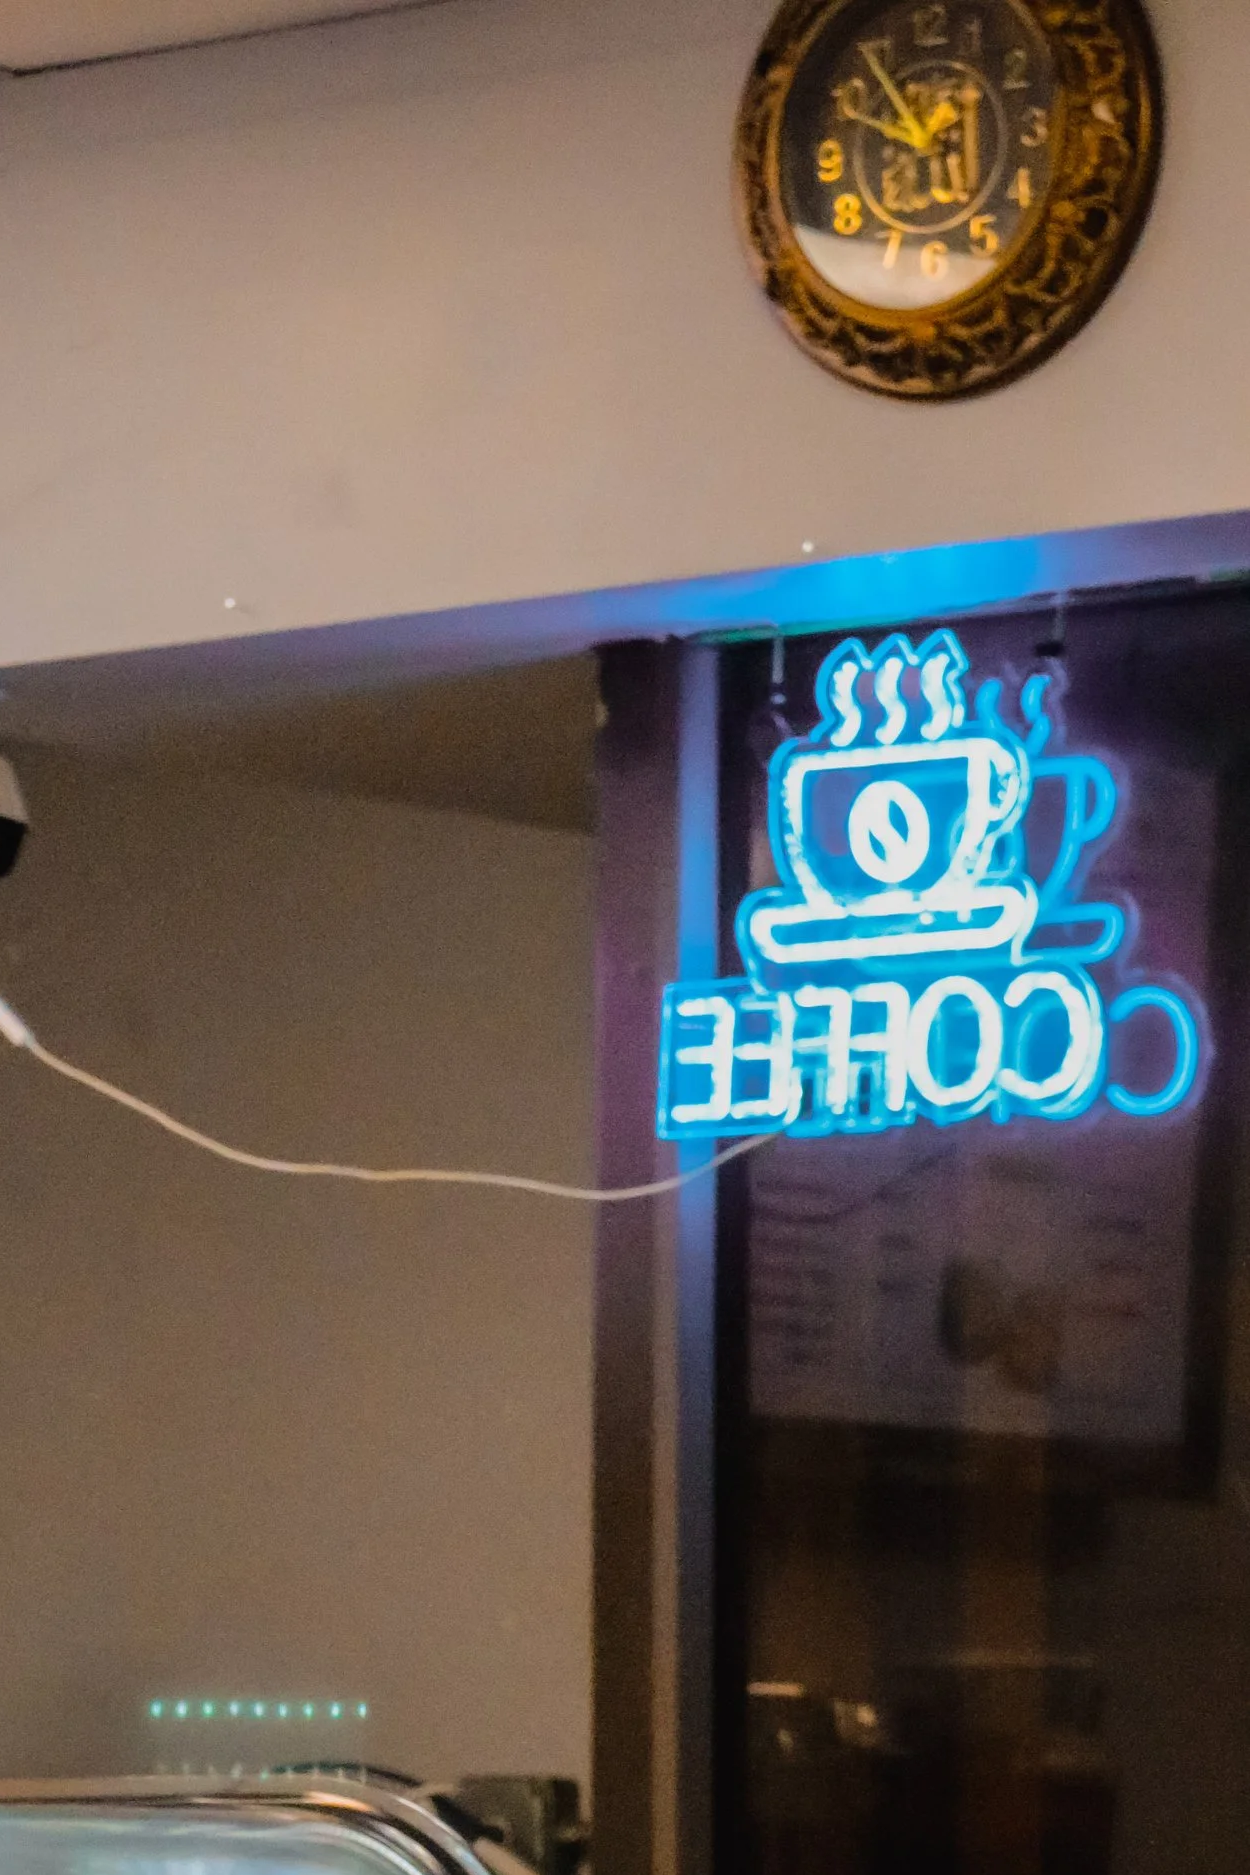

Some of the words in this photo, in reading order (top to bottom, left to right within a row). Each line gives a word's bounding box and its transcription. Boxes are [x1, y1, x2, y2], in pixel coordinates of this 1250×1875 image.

[1020, 105, 1048, 147] 3
[817, 138, 844, 183] 9
[1006, 167, 1031, 209] 4
[833, 192, 863, 236] 8
[969, 213, 1000, 258] 5
[875, 227, 903, 270] 7
[919, 240, 949, 282] 6
